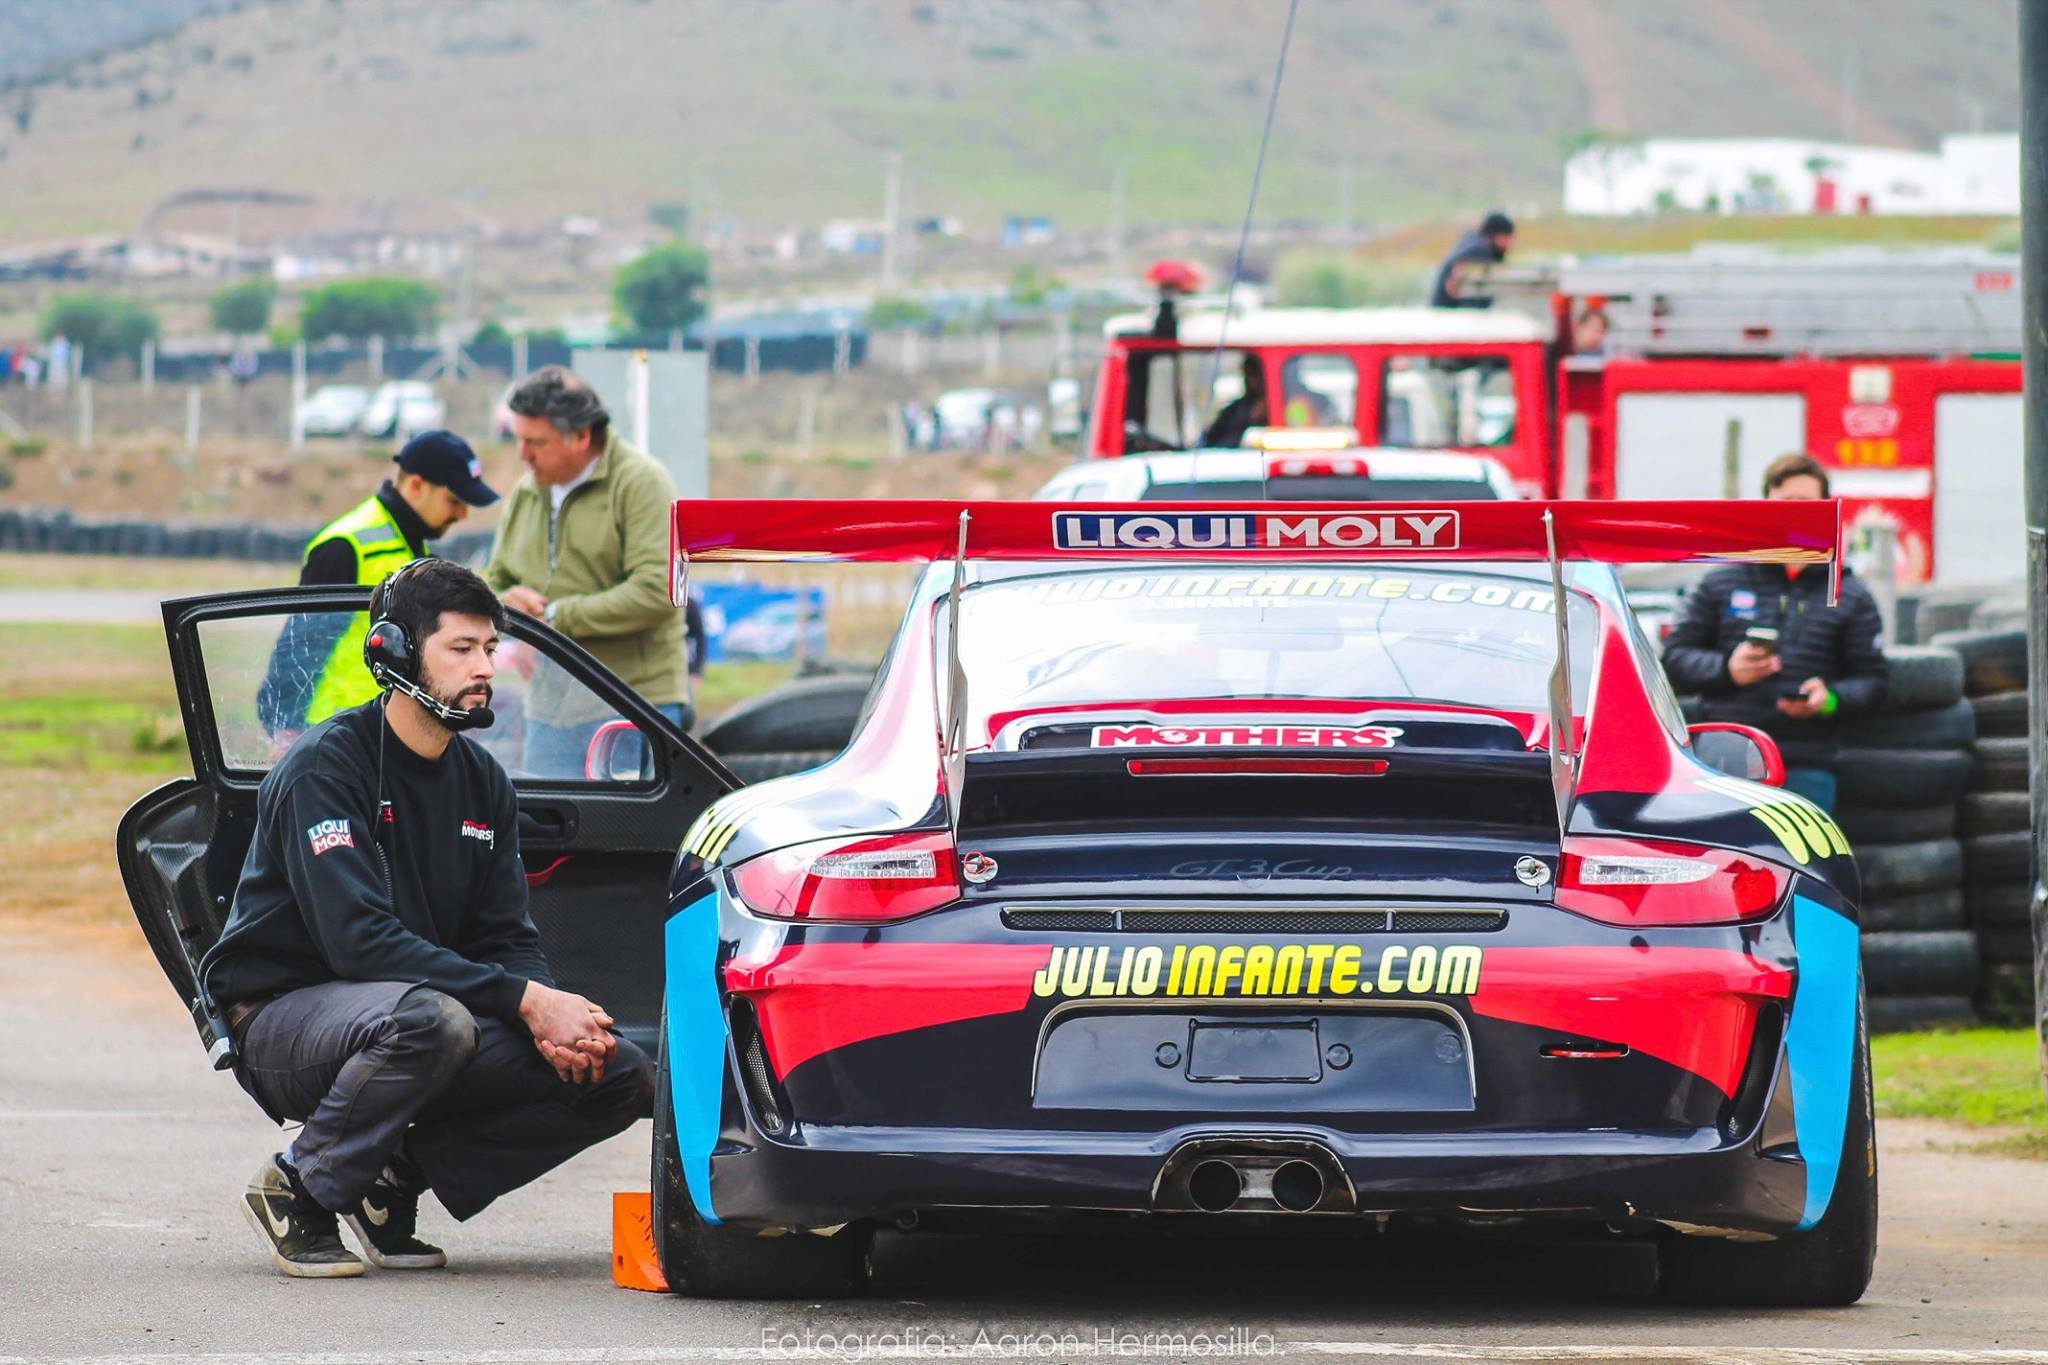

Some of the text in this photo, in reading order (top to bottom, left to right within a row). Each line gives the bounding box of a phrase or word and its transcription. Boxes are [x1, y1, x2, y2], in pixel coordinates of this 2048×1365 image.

[1066, 516, 1453, 548] LIQUI MOLY
[1098, 727, 1390, 748] MOTHERS
[309, 819, 349, 841] LIQUI
[313, 833, 353, 855] MOLY
